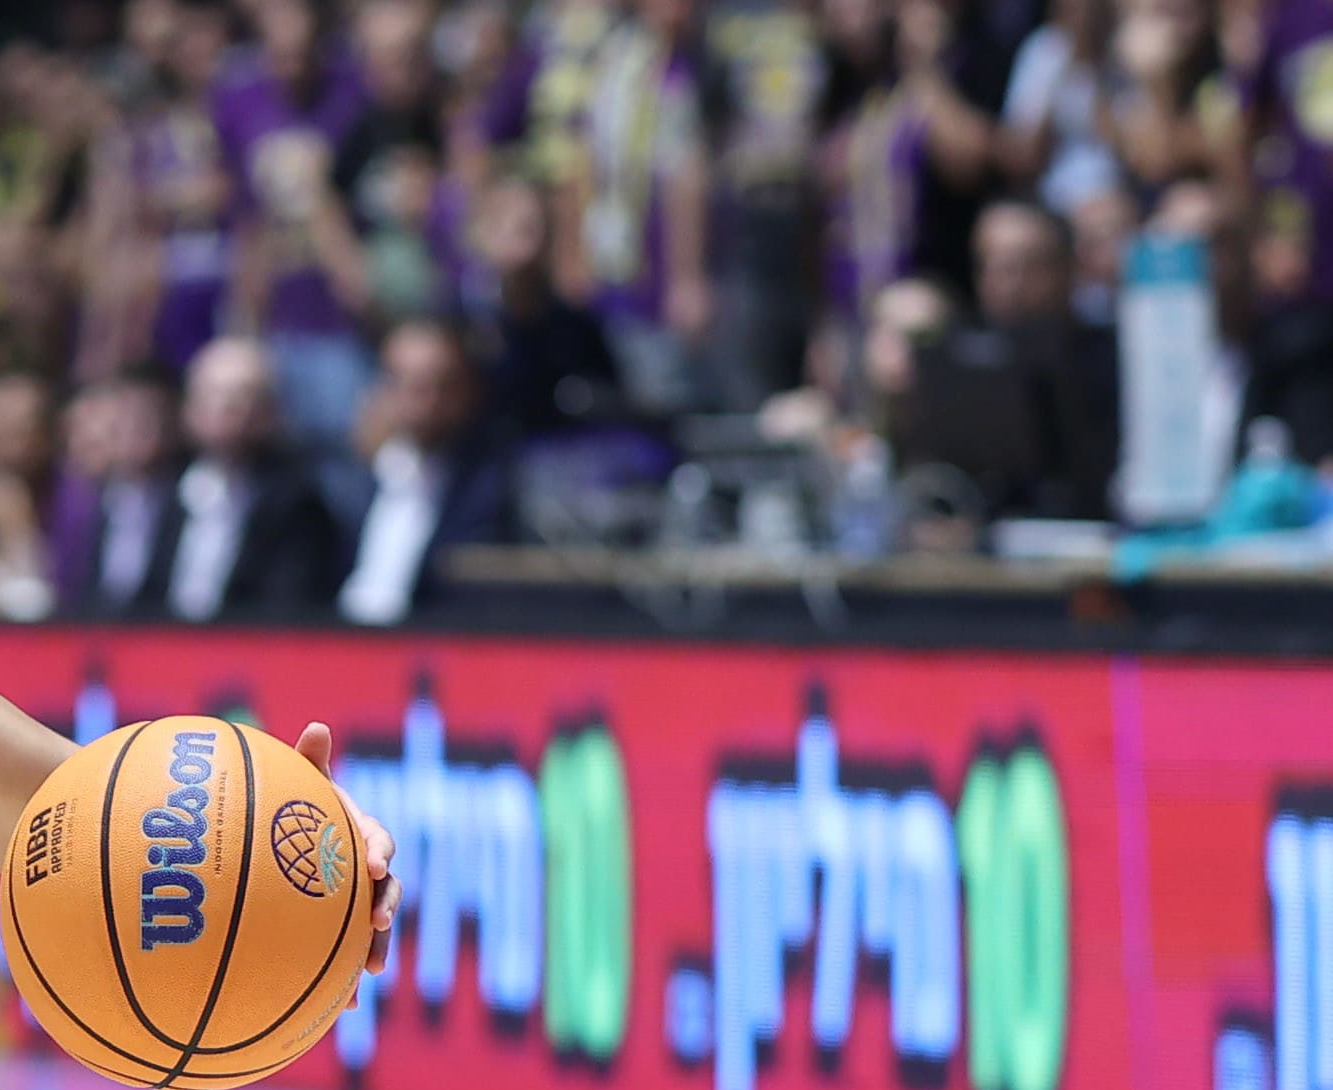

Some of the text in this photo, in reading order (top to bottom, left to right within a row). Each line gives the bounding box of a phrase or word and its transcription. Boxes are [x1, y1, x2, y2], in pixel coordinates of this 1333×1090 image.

[26, 807, 52, 887] FIBA
[51, 801, 66, 874] APPROVED
[140, 731, 217, 952] Wilson
[214, 830, 223, 875] INDOOR
[539, 726, 632, 1059] 10
